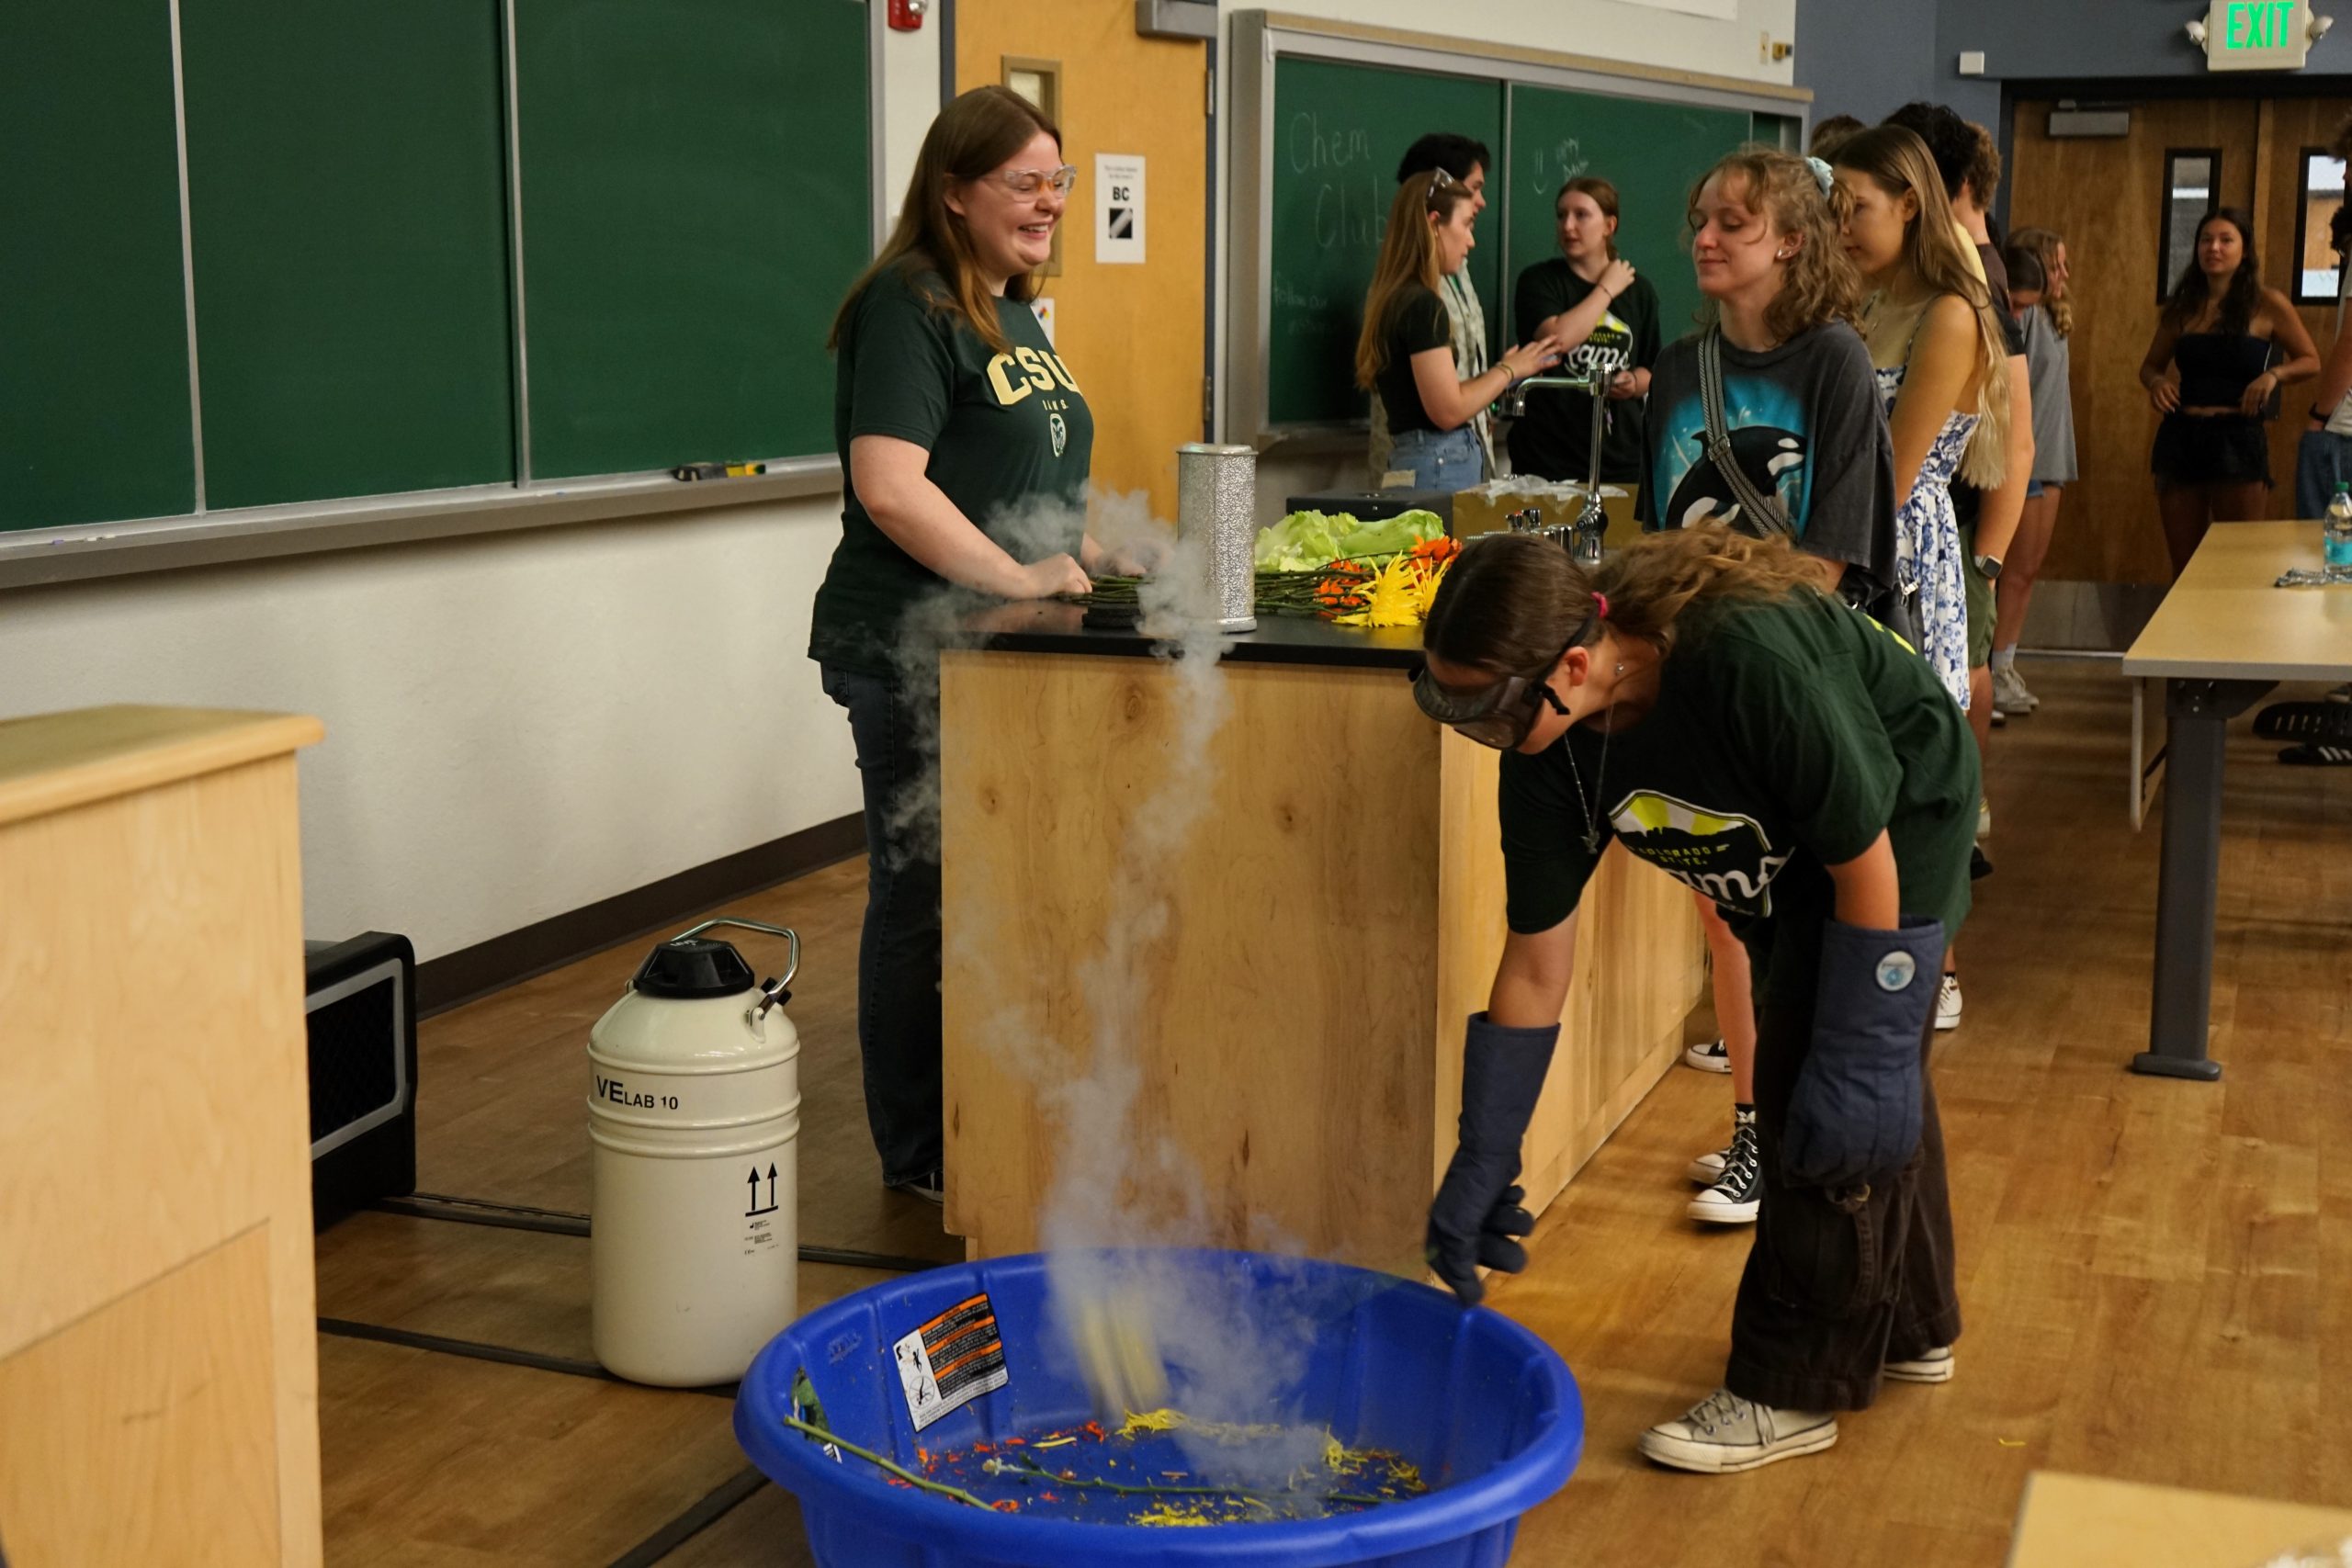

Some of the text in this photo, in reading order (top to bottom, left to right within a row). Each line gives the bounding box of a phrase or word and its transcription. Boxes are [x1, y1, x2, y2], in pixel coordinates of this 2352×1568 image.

[2226, 1, 2294, 50] EXIT
[1289, 111, 1371, 174] Chem
[1113, 186, 1130, 201] BC
[1316, 174, 1387, 249] Club
[987, 346, 1083, 405] CSU
[661, 1095, 679, 1110] 10
